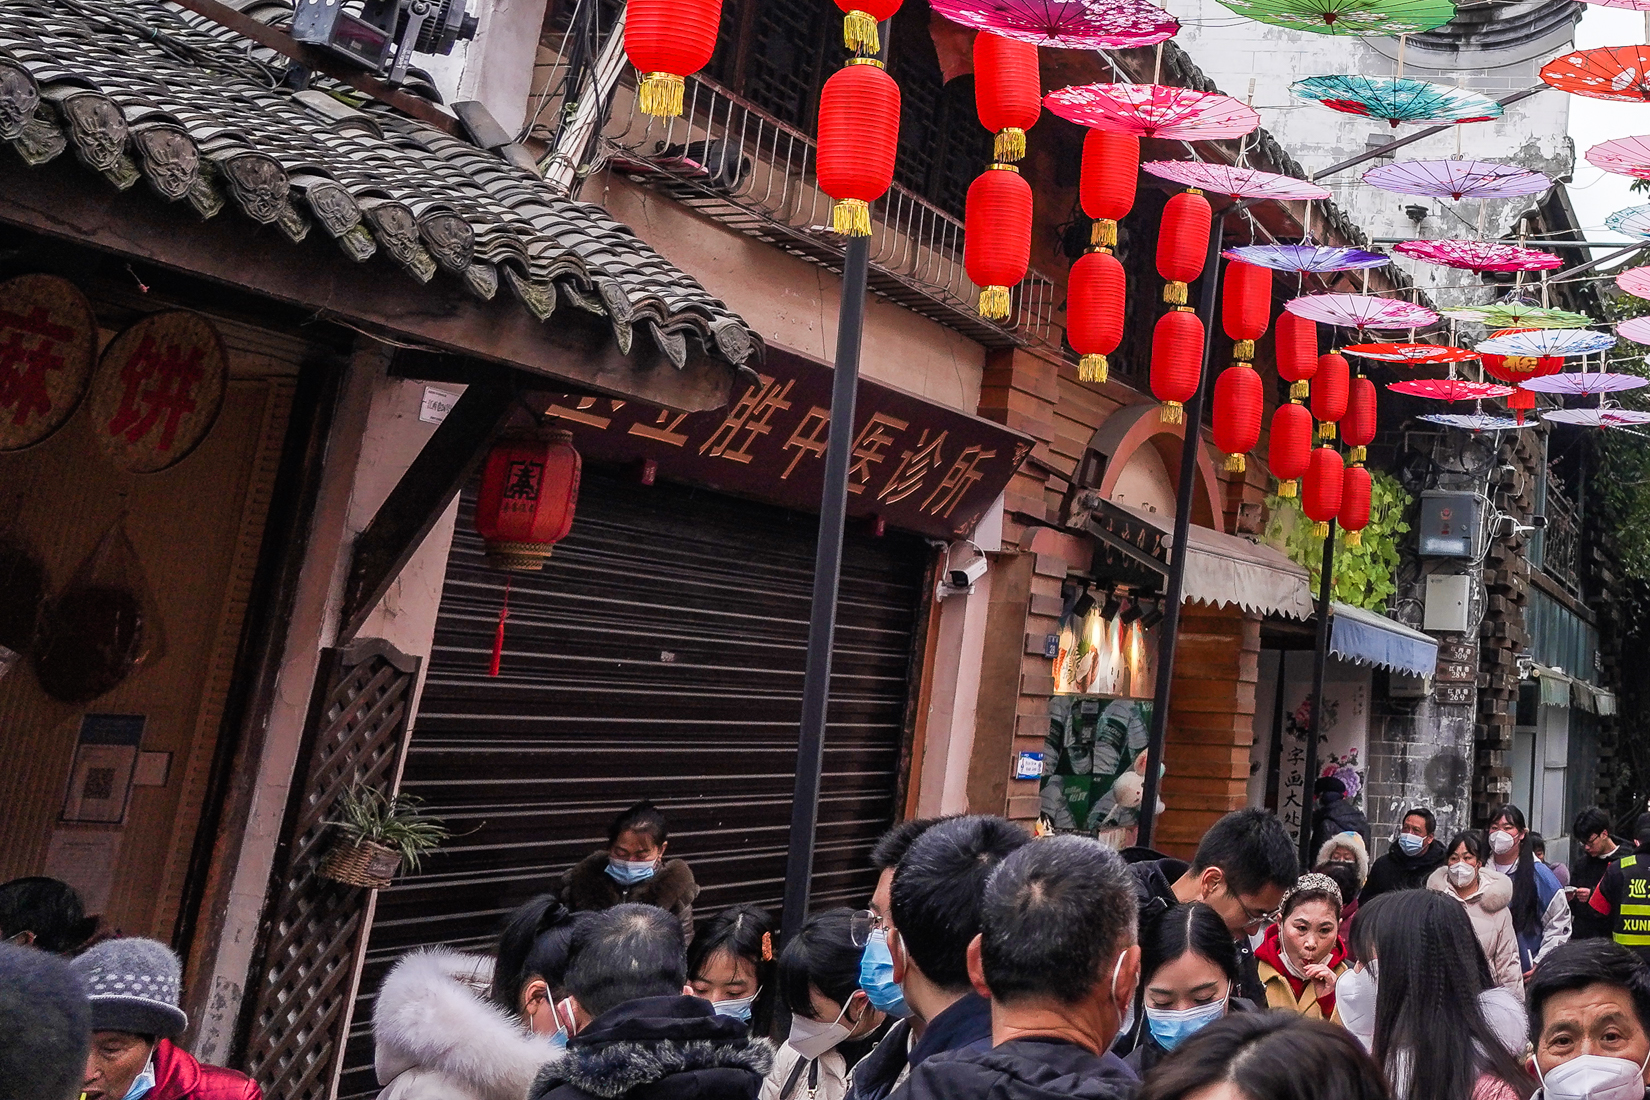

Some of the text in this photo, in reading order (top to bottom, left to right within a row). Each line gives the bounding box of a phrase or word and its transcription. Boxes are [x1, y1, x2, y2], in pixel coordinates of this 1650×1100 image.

[545, 373, 997, 518] 胜中医诊所
